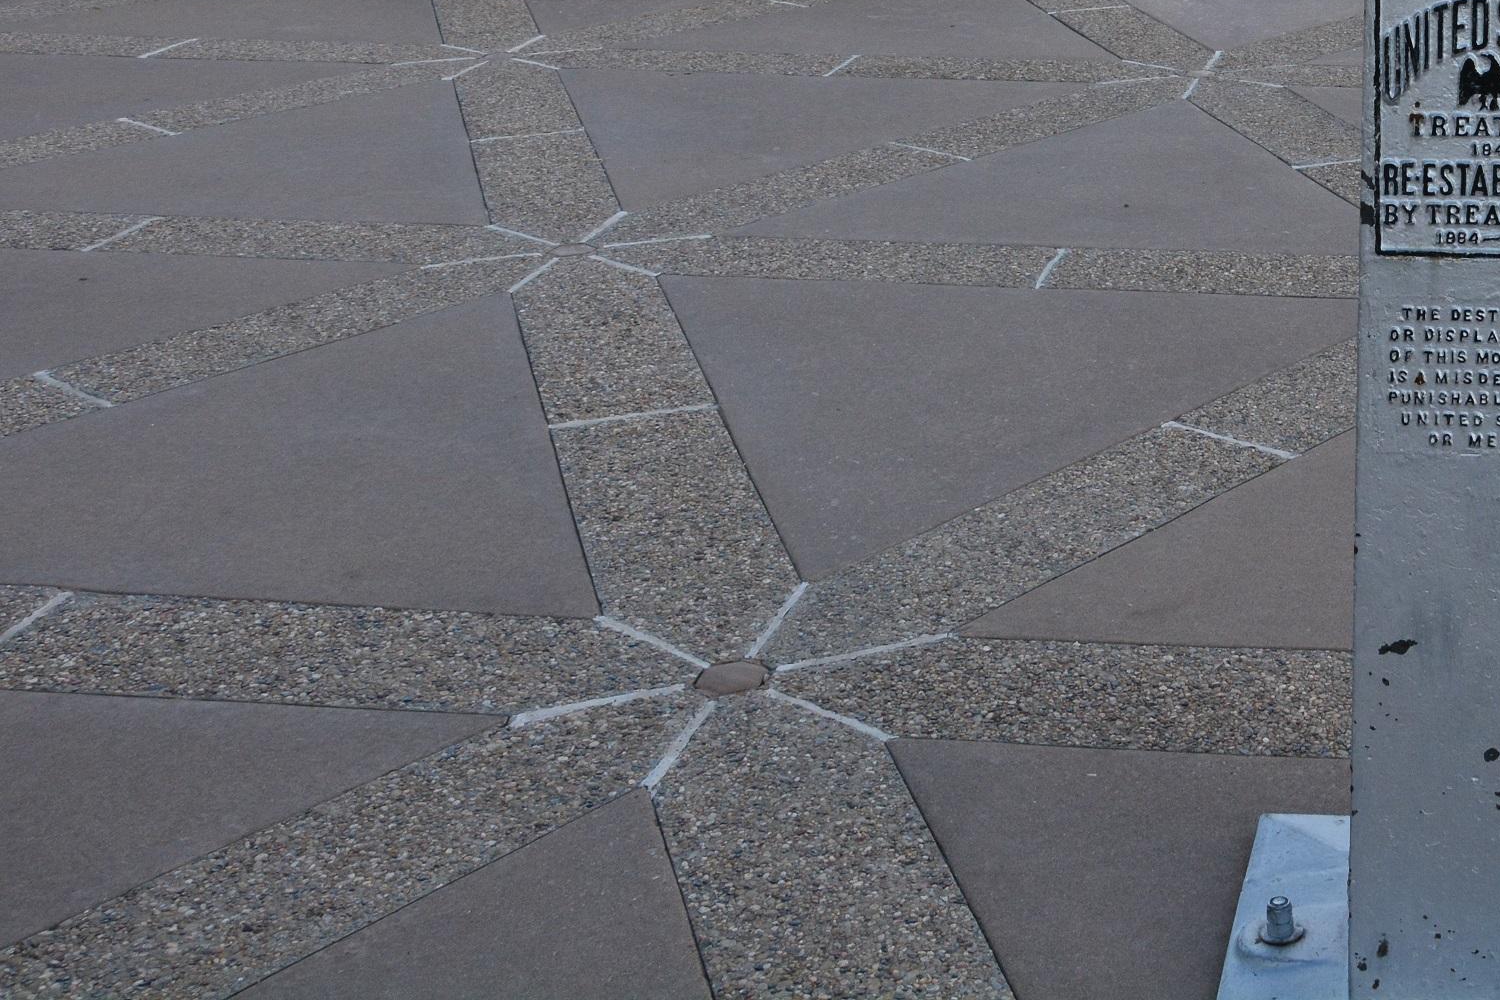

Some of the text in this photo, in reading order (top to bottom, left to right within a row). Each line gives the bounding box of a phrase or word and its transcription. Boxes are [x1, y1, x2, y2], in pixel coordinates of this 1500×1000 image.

[1384, 203, 1418, 226] BY
[1402, 307, 1441, 321] THE
[1389, 328, 1415, 342] OR
[1389, 349, 1416, 363] OF
[1423, 350, 1467, 365] THIS
[1389, 371, 1408, 384] IS
[1414, 371, 1427, 385] A
[1401, 414, 1484, 427] UNITED
[1429, 434, 1453, 447] OR
